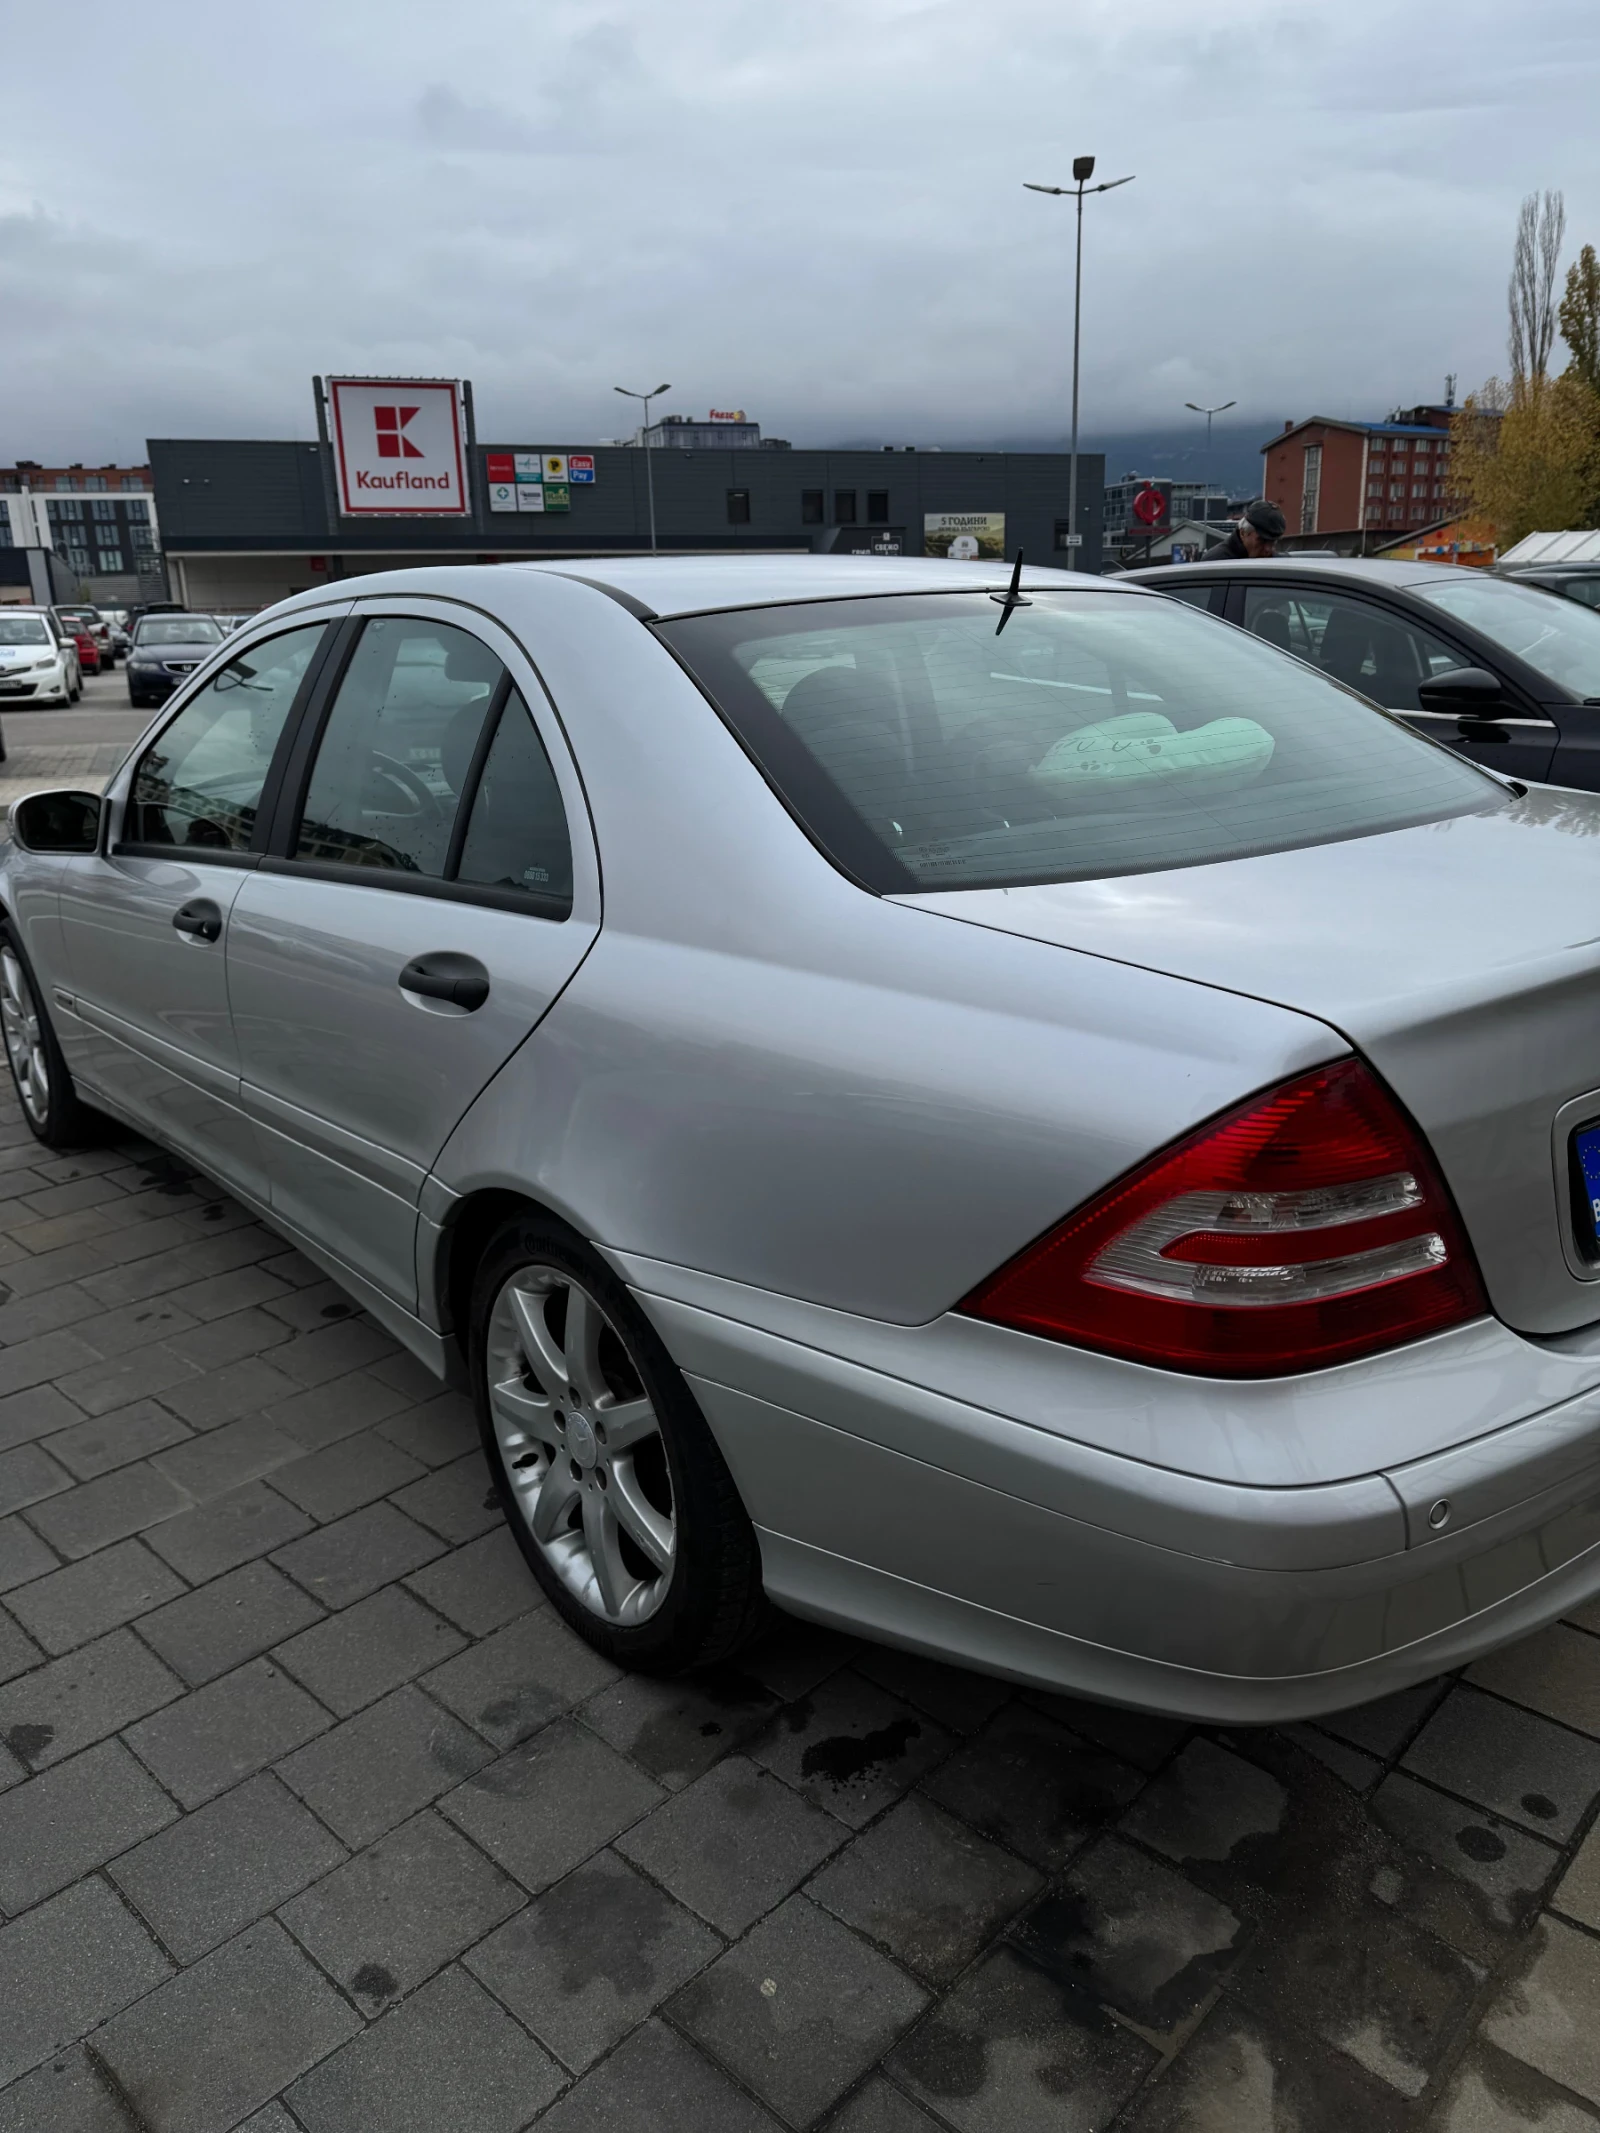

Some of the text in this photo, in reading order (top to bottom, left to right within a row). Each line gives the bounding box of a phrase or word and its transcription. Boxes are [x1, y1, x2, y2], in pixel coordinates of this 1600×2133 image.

[572, 459, 591, 468] Easy
[356, 470, 450, 490] Kaufland
[573, 471, 588, 480] Pay
[941, 516, 987, 526] 5 ГОДИНИ
[874, 543, 899, 551] СВЕЖО
